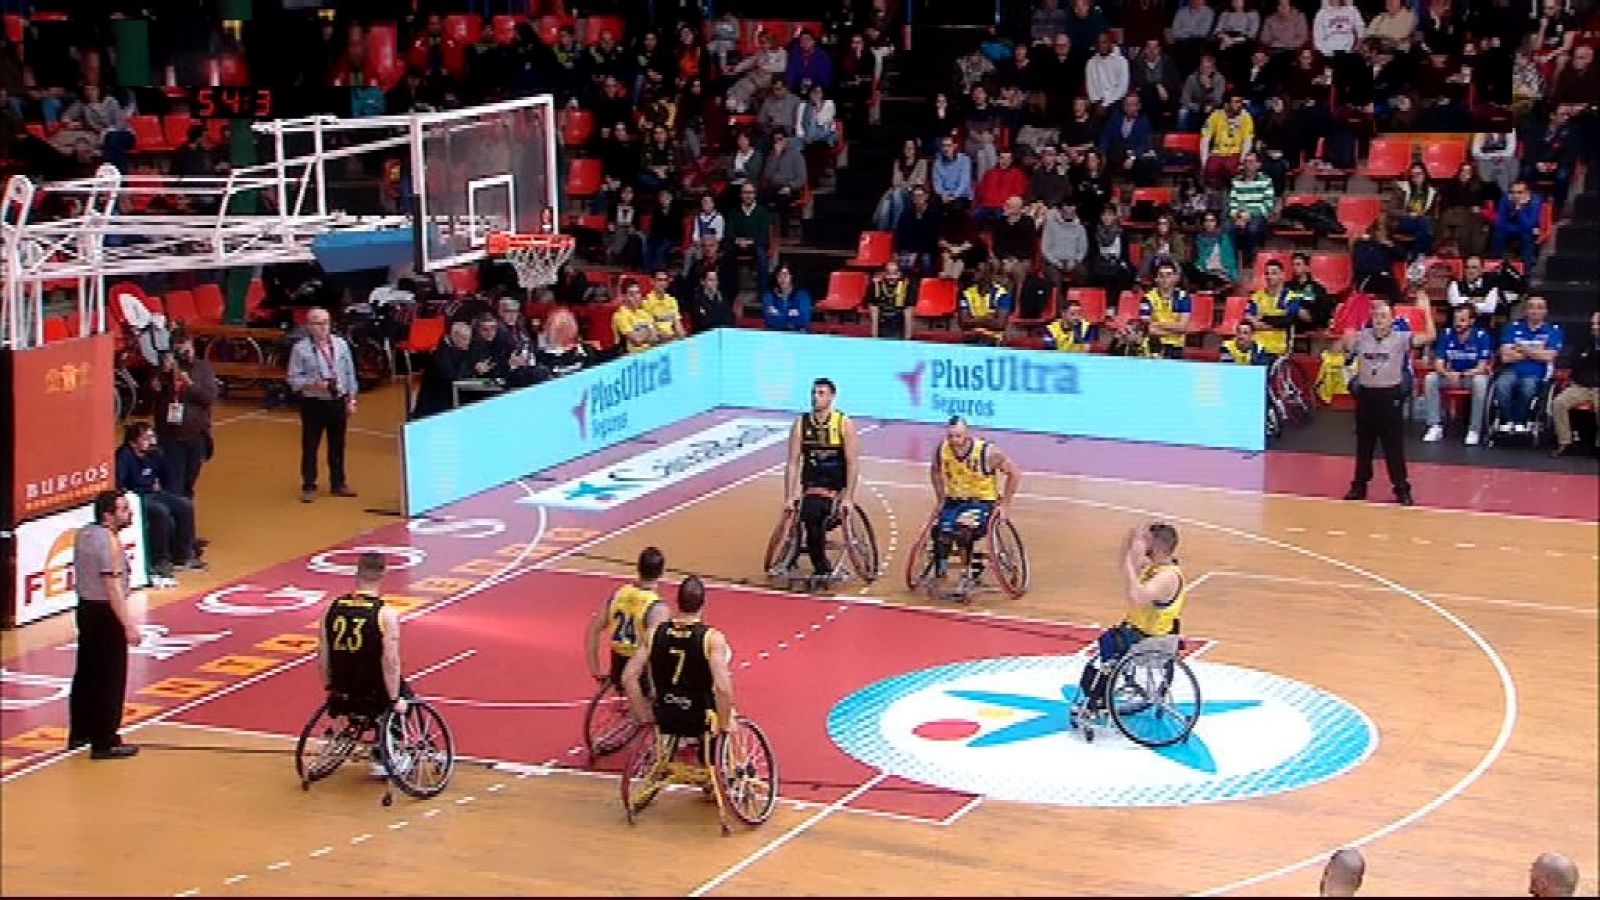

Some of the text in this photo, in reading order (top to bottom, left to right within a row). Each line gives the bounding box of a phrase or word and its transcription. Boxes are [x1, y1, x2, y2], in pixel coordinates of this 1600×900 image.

[590, 356, 673, 415] PlusUltra
[930, 356, 1081, 395] PlusUltra
[25, 462, 109, 501] BURGOS
[332, 615, 367, 653] 23
[611, 609, 638, 644] 24
[668, 646, 687, 685] 7
